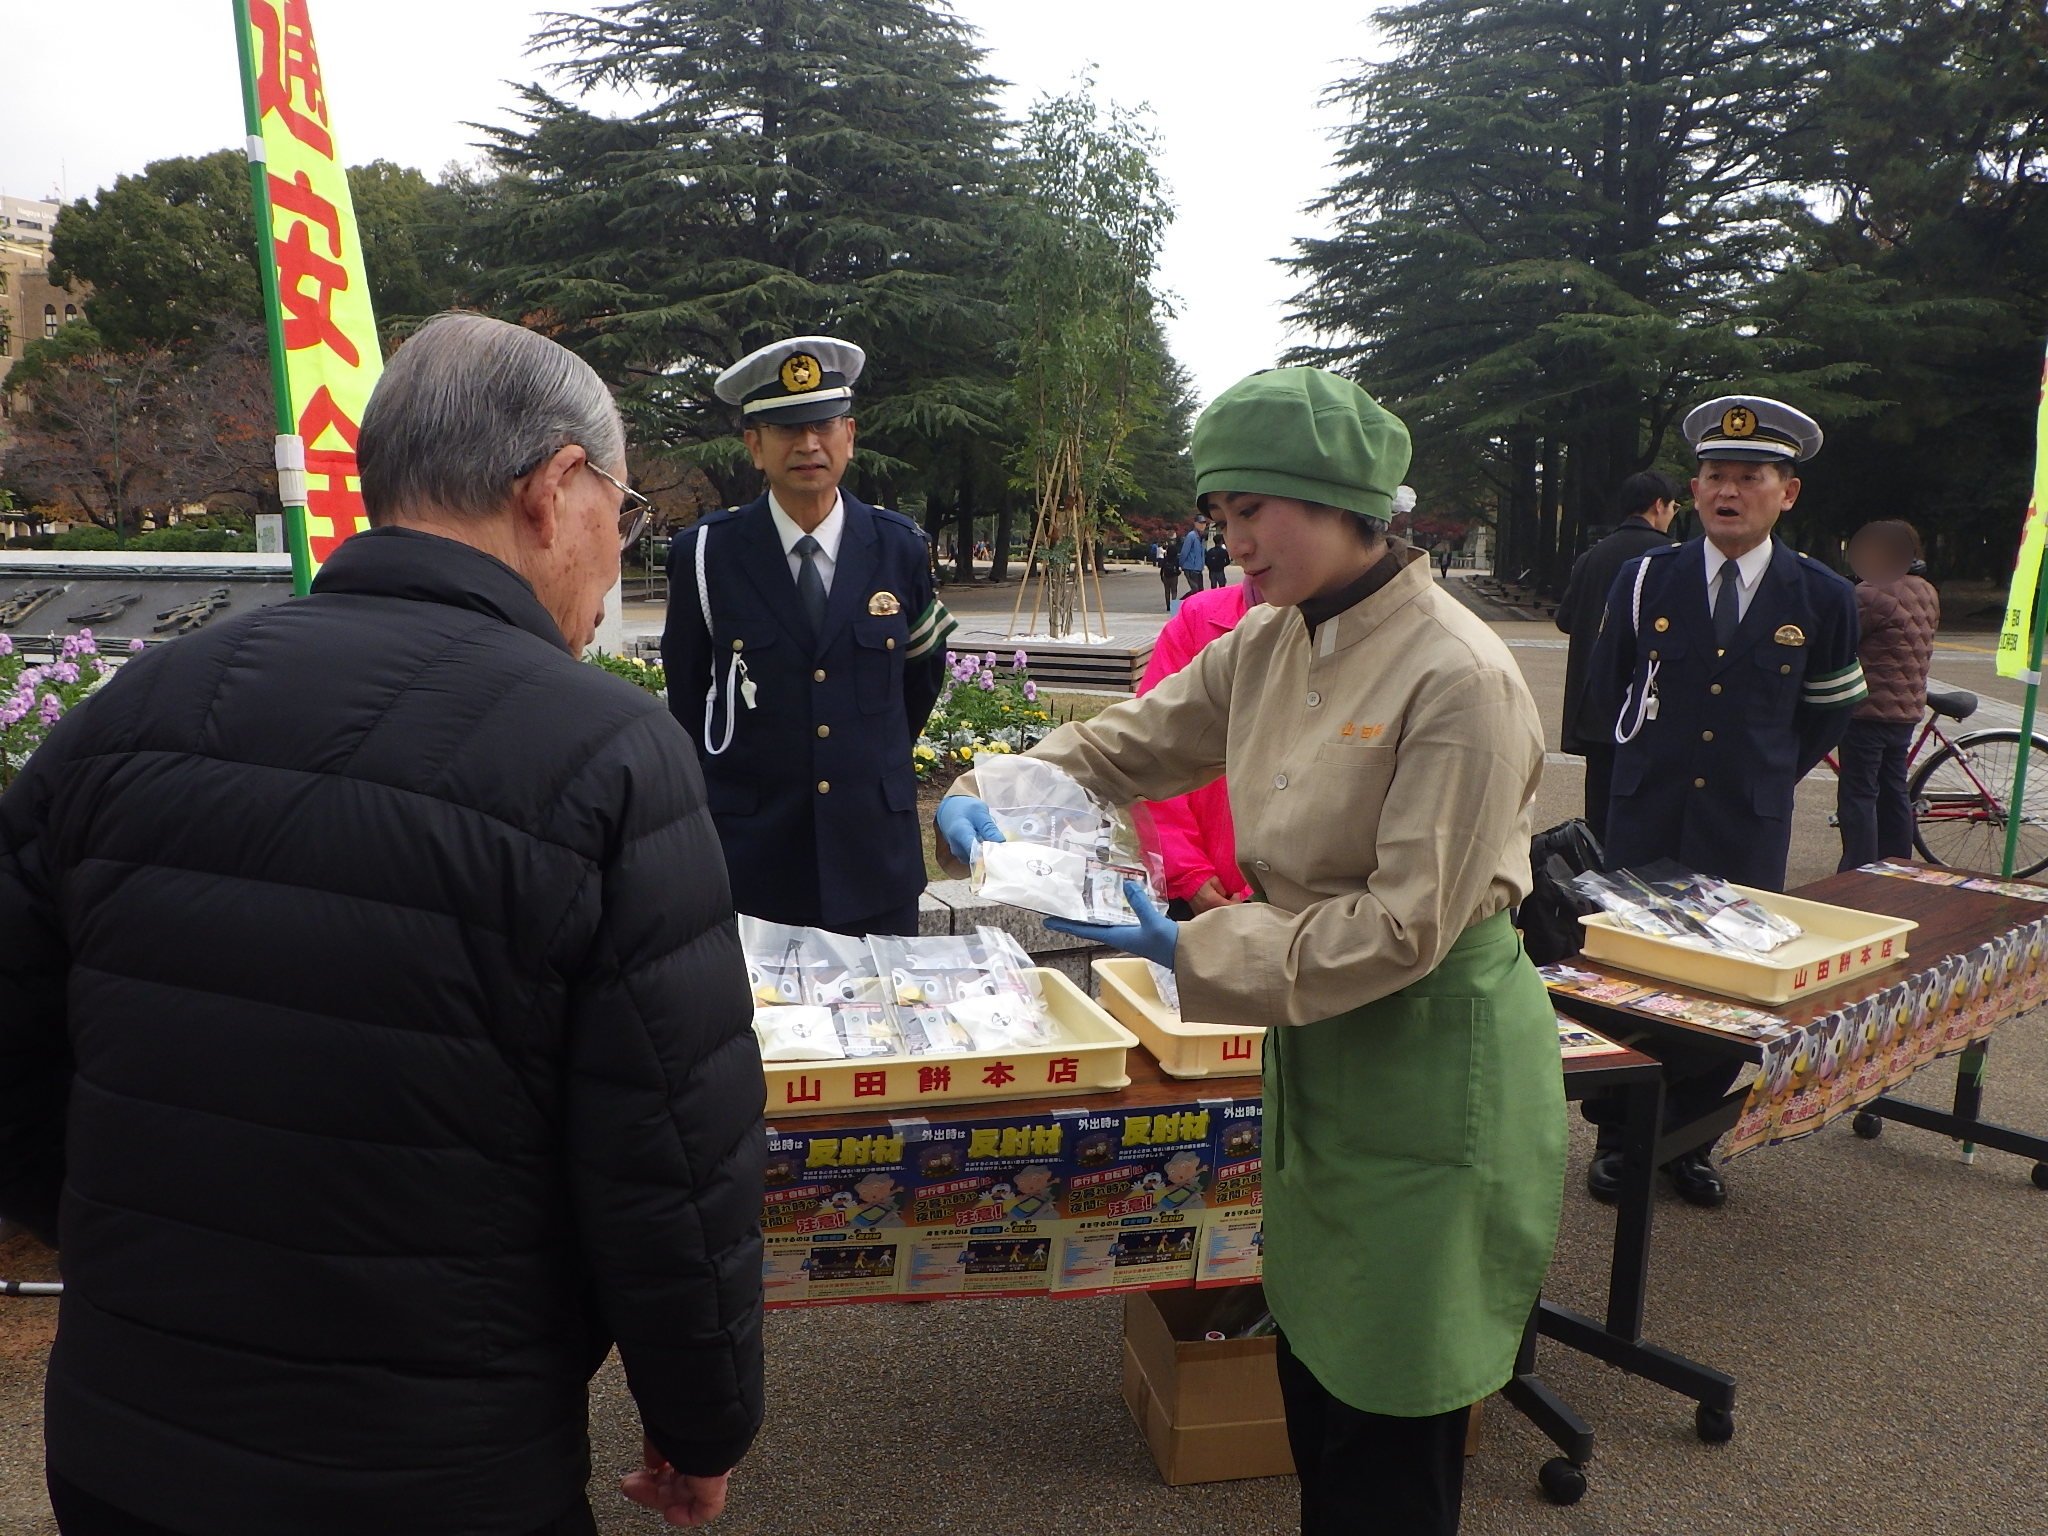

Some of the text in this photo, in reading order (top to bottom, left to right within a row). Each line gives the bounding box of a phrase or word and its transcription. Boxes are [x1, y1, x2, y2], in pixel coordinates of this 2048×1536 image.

[1793, 938, 1893, 989] 山田餅本店
[1223, 1036, 1251, 1060] 山
[787, 1057, 1080, 1104] 山田餅本店
[921, 1122, 1063, 1158] 外出時は 反射材
[1078, 1108, 1209, 1147] 外出時は 反射材
[768, 1132, 904, 1168] 出時は 反射材
[1220, 1160, 1261, 1178] 歩行者・自
